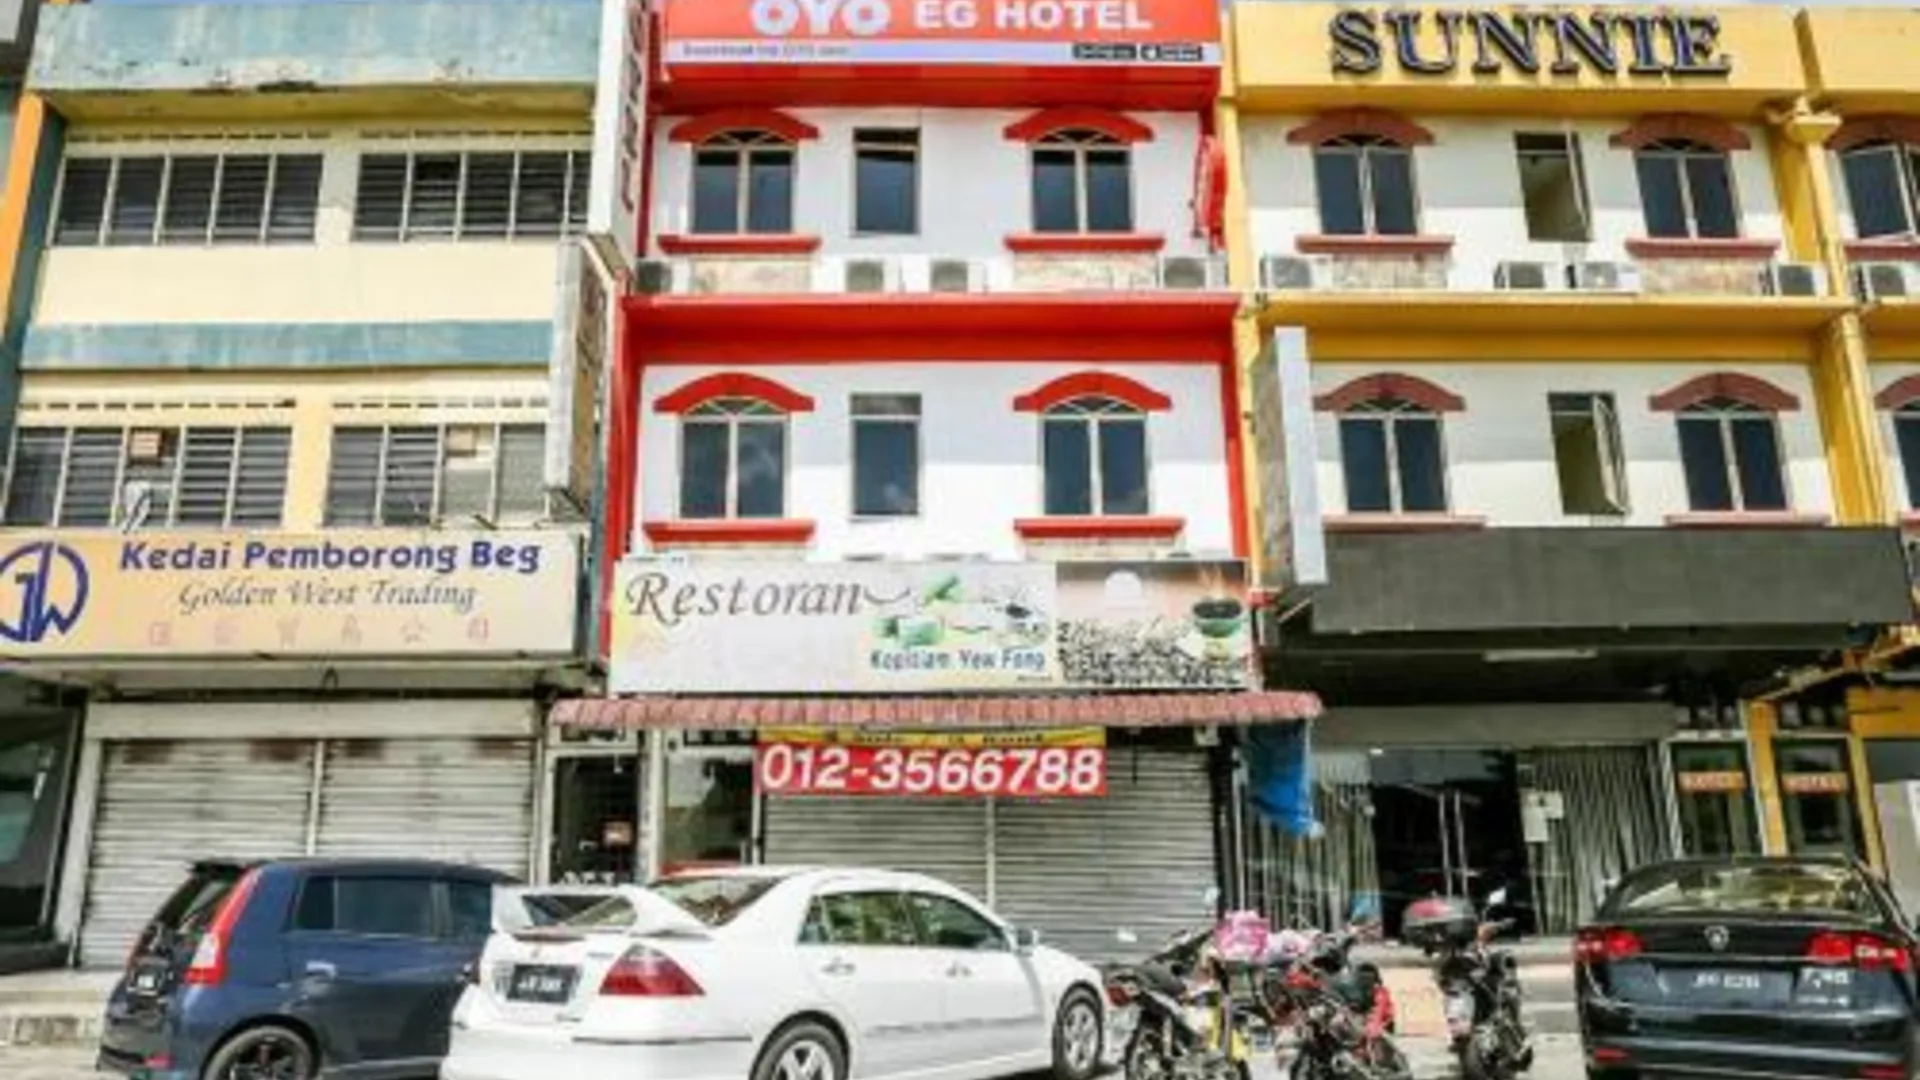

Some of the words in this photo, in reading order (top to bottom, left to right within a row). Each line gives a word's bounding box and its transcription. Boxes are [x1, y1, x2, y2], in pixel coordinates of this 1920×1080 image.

[751, 0, 891, 36] OYO
[915, 1, 979, 29] EG
[994, 0, 1153, 30] HOTEL
[1331, 9, 1731, 75] SUNNIE
[120, 541, 231, 570] Kedai
[243, 541, 459, 574] Pemborong
[470, 540, 542, 574] Beg
[178, 579, 277, 616] Golden
[286, 578, 357, 605] West
[367, 577, 476, 614] Trading
[625, 571, 864, 627] Restoran
[761, 744, 1104, 792] 012-3566788
